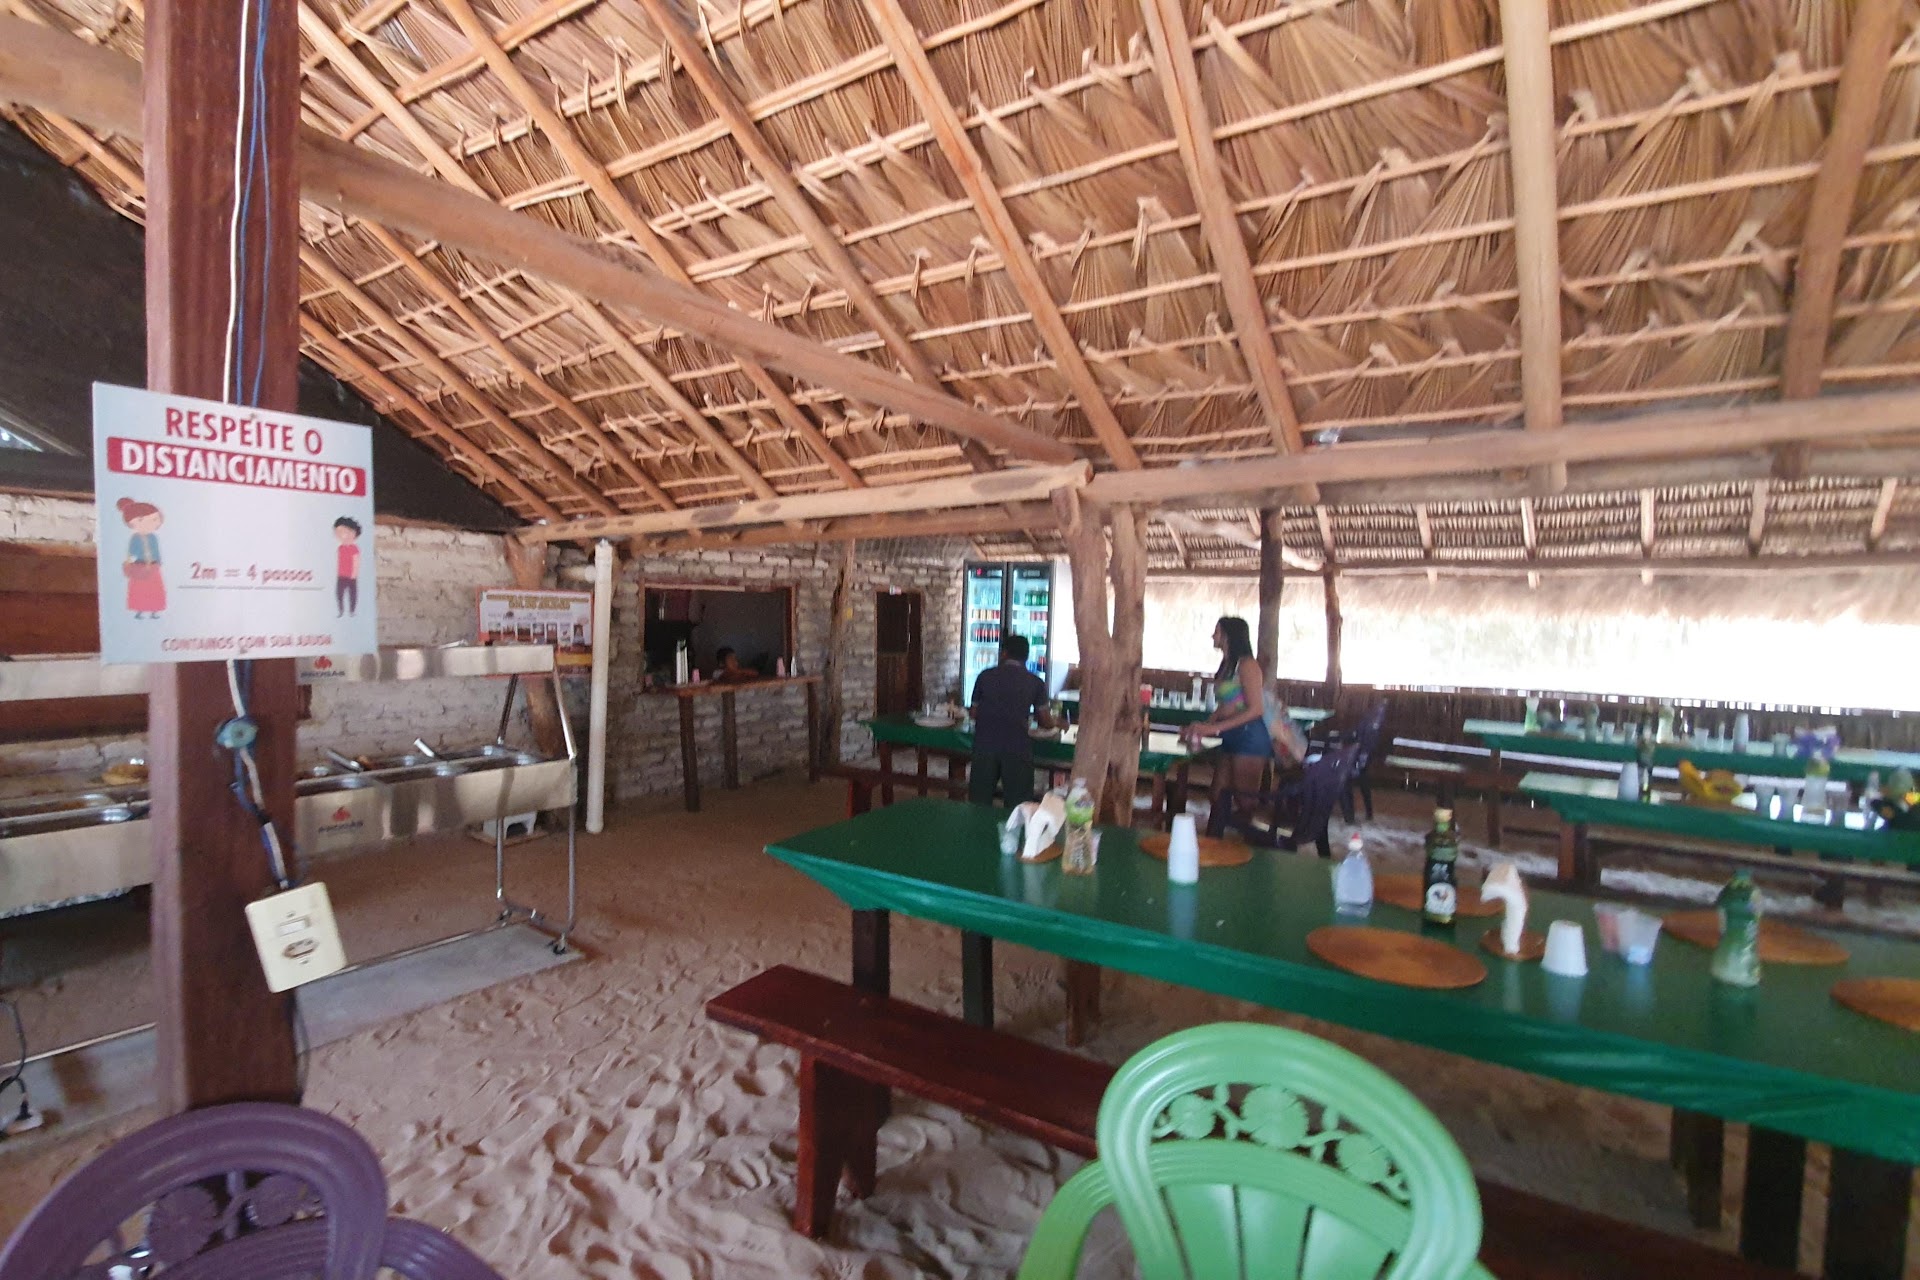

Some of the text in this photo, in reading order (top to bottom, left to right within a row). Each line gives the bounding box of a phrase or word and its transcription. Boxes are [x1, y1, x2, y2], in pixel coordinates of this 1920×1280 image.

[166, 407, 323, 456] RESPEITE O
[121, 442, 357, 494] DISTANCIAMENTO
[190, 561, 217, 580] 2m
[246, 562, 258, 581] 4
[262, 568, 313, 585] passos
[162, 636, 235, 651] CONTAMOS
[238, 635, 267, 650] COM
